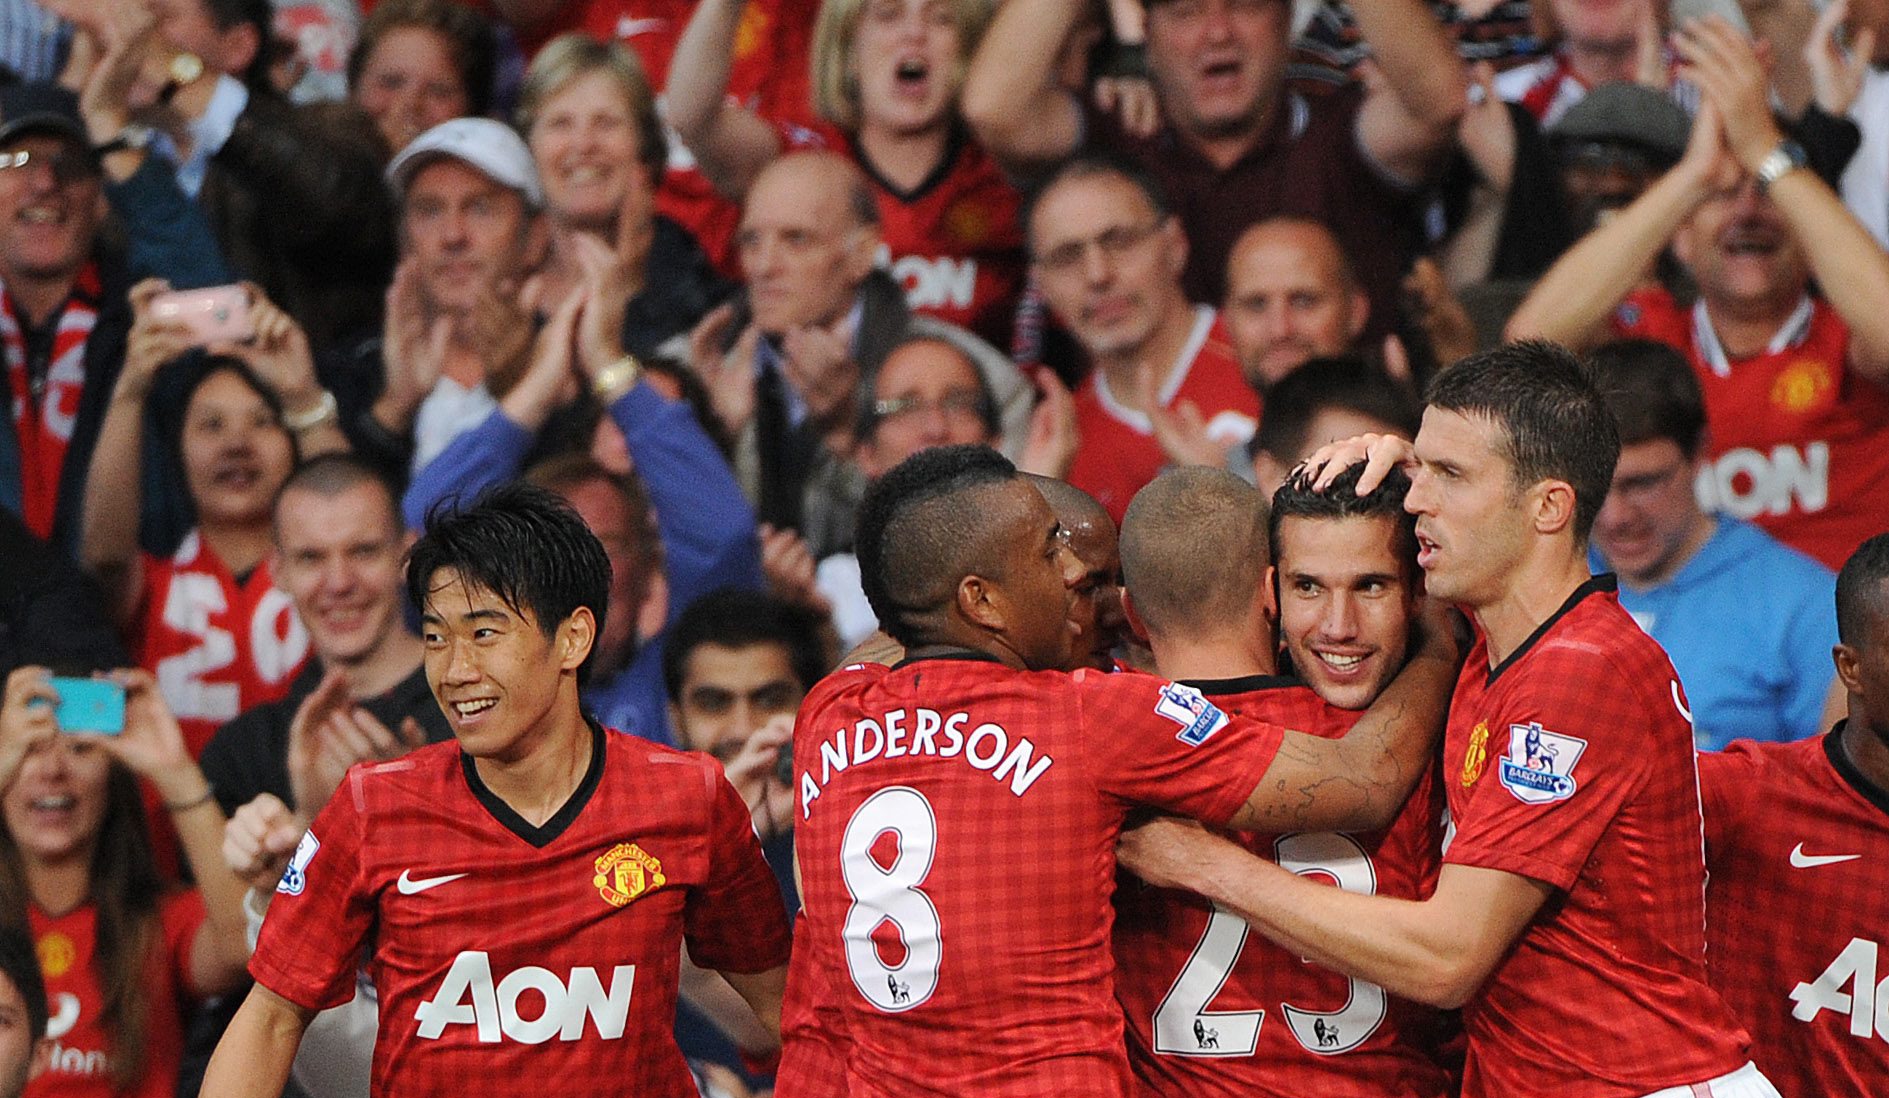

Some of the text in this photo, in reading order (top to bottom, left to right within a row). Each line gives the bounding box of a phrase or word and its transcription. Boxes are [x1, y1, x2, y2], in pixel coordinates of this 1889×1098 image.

[874, 244, 977, 310] ON
[1694, 442, 1829, 520] ON
[800, 708, 1053, 820] ANDERSON
[841, 785, 943, 1013] 8
[414, 950, 636, 1045] AON
[1788, 936, 1889, 1045] A
